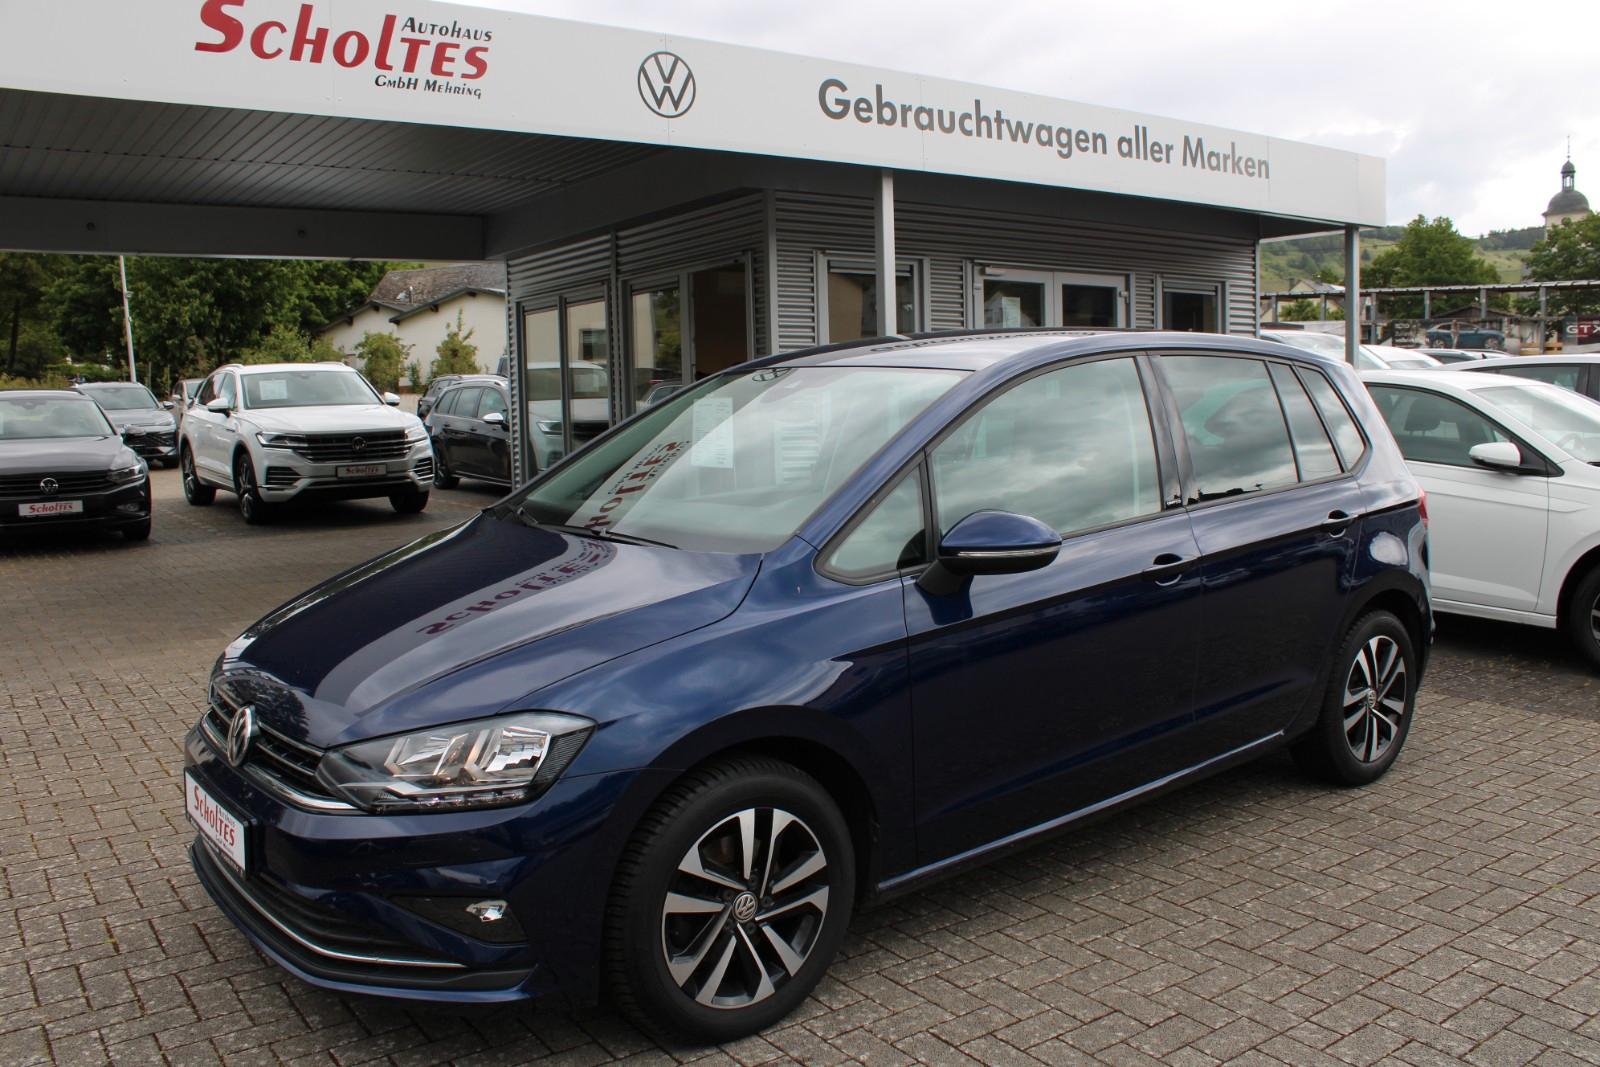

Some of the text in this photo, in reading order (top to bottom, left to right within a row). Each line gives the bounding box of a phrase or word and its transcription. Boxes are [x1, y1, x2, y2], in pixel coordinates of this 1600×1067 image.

[374, 74, 419, 90] GmbH
[818, 78, 1271, 180] Gebrauchtwagen aller Marken
